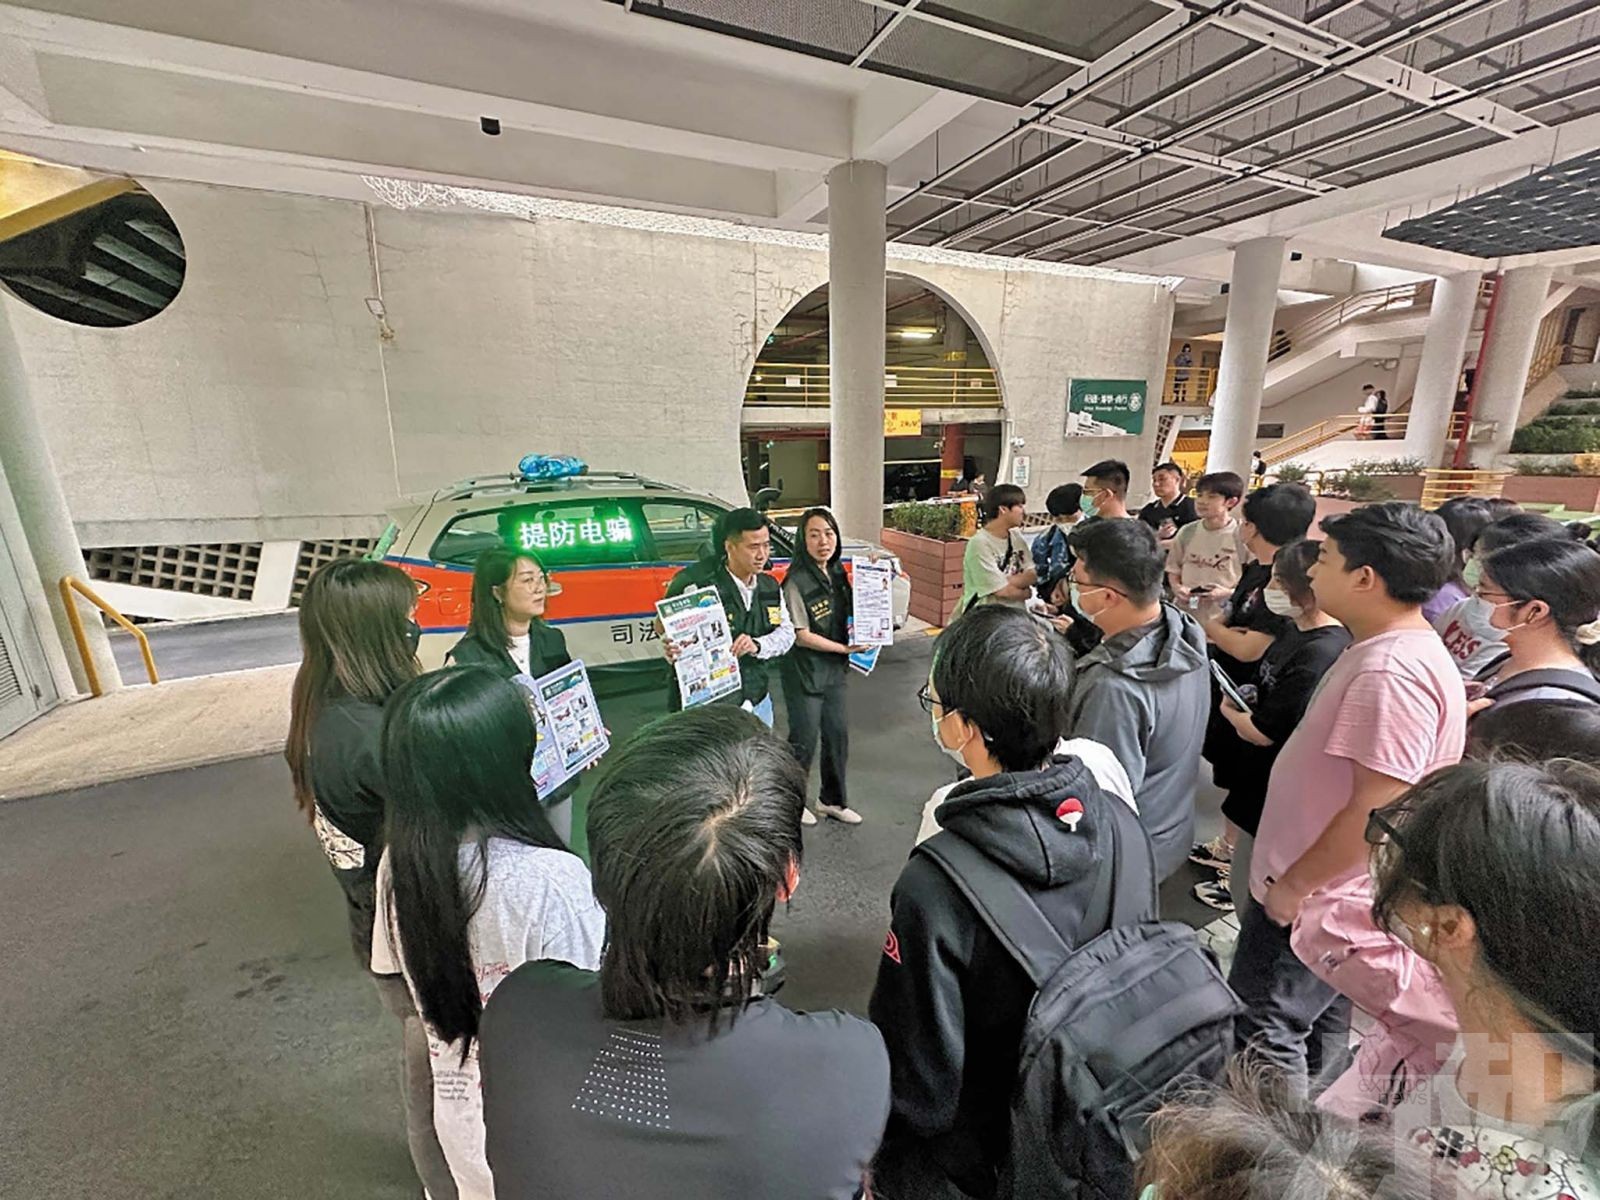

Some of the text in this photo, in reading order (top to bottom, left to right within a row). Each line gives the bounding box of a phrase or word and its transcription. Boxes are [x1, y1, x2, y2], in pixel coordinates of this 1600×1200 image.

[518, 515, 633, 549] 提防电骗
[610, 620, 661, 645] 司法
